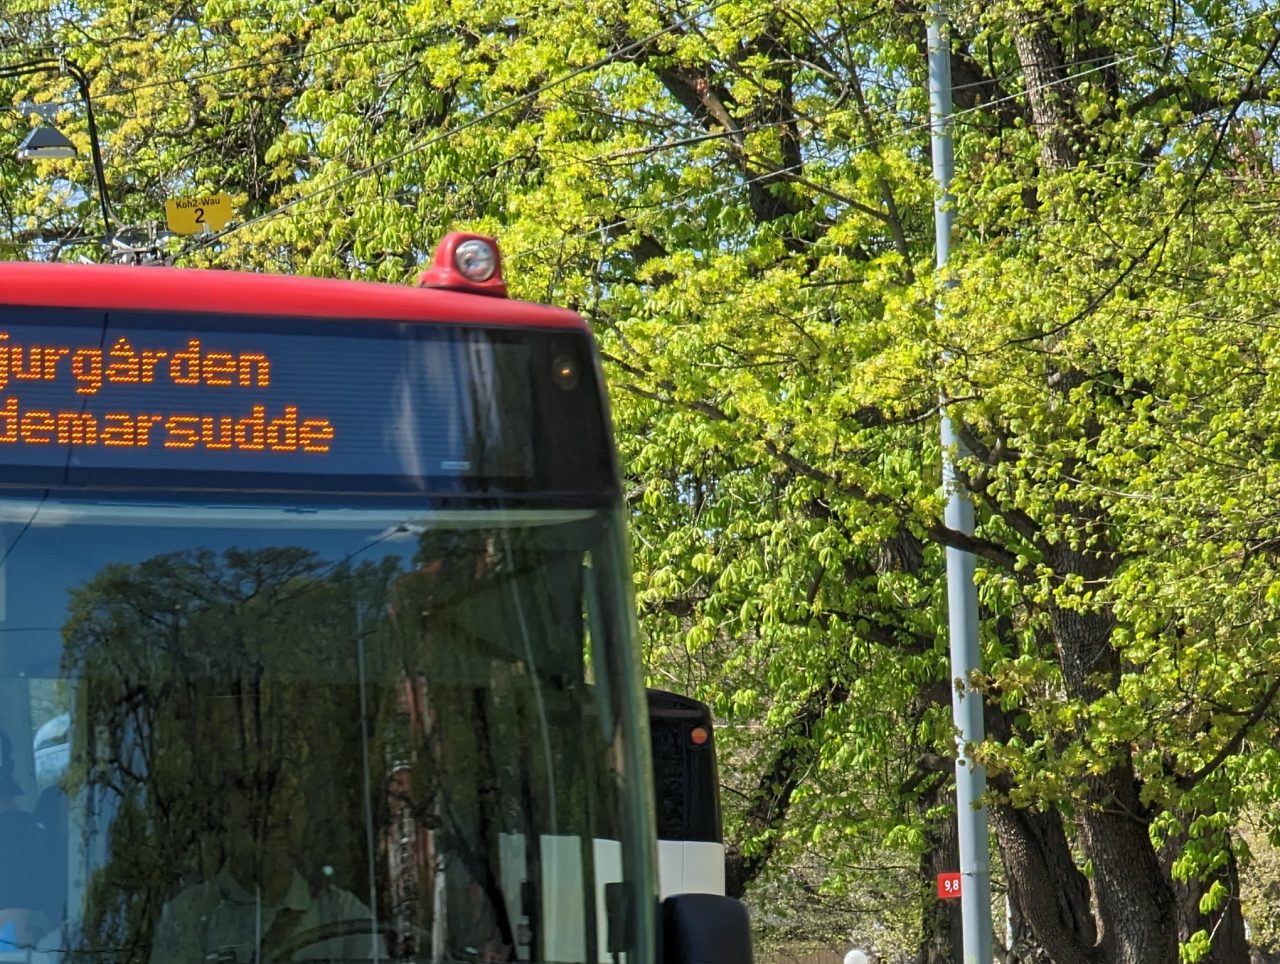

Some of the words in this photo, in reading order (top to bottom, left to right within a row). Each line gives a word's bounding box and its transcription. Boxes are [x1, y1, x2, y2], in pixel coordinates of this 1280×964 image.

[175, 198, 220, 209] Koh2-Wau
[194, 208, 205, 223] 2
[944, 879, 959, 893] 9,8
